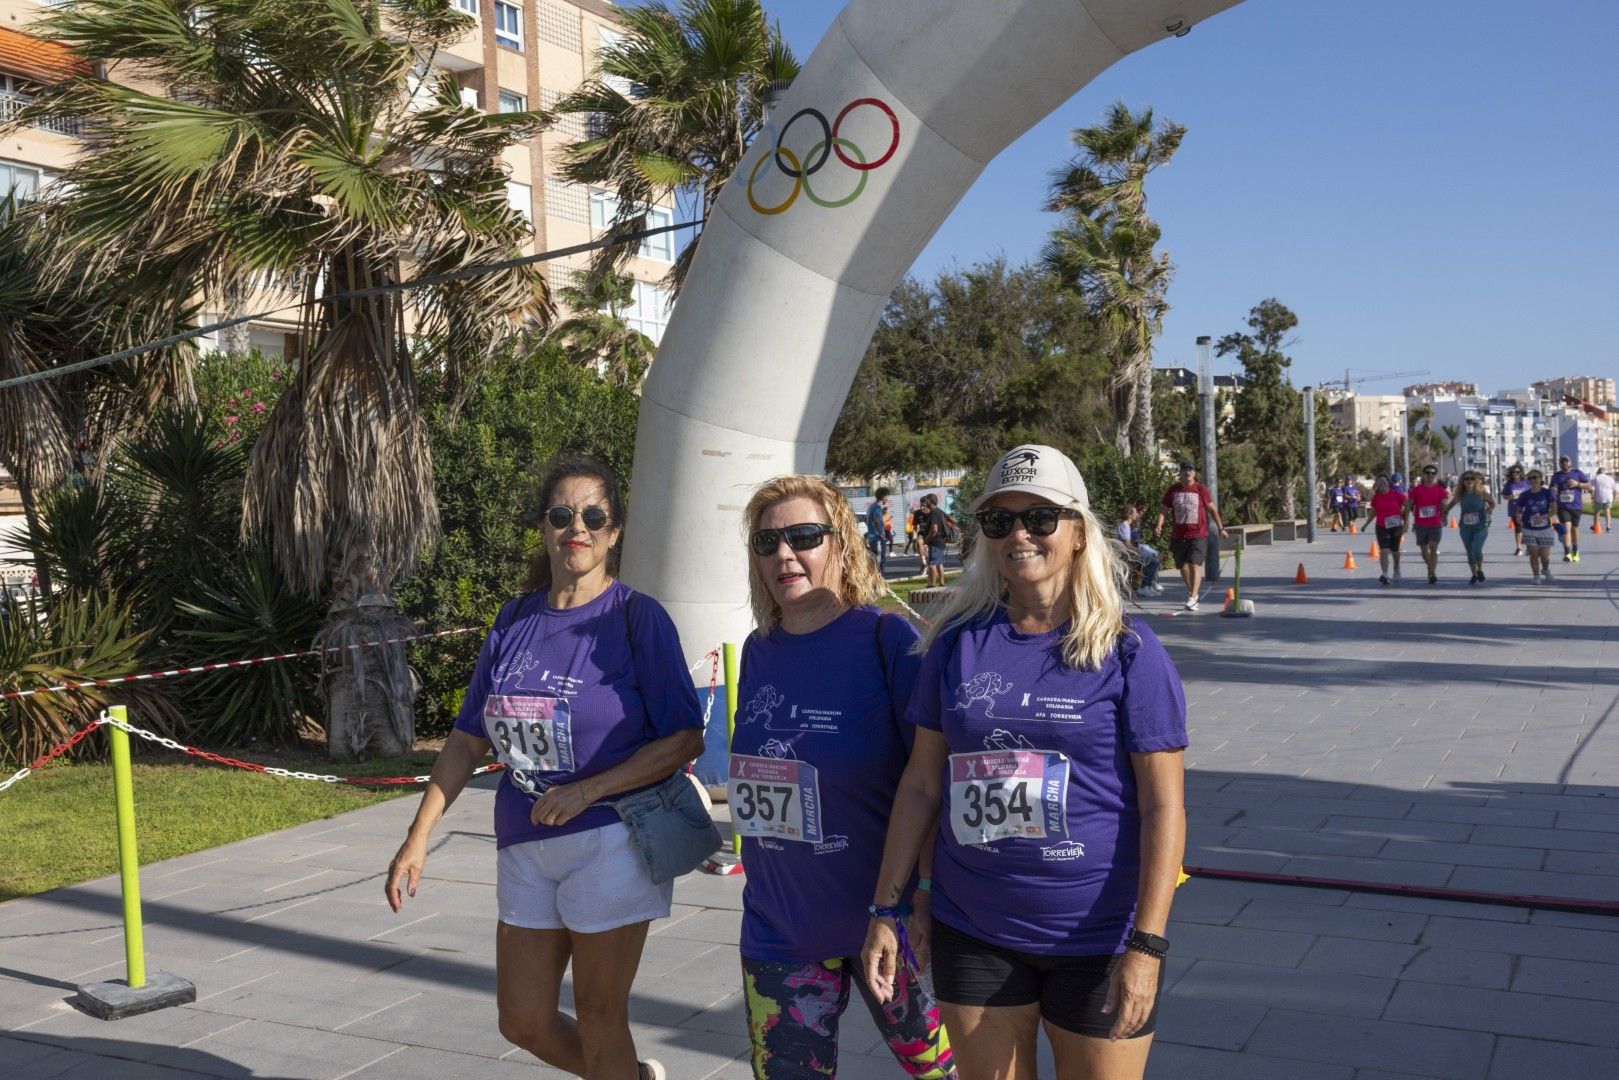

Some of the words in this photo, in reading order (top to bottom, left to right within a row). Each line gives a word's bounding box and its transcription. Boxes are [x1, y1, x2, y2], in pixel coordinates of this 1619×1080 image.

[1001, 467, 1037, 478] LUXOR
[1002, 475, 1034, 484] EGYPT
[1021, 692, 1031, 706] X
[494, 720, 549, 756] 313
[556, 722, 571, 765] MARCHA
[737, 760, 746, 777] X
[965, 760, 977, 778] X
[736, 782, 793, 823] 357
[803, 787, 817, 836] MARCHA
[963, 781, 1033, 828] 354
[1046, 780, 1061, 832] MARCHA
[1040, 846, 1085, 859] TORREVIEJA
